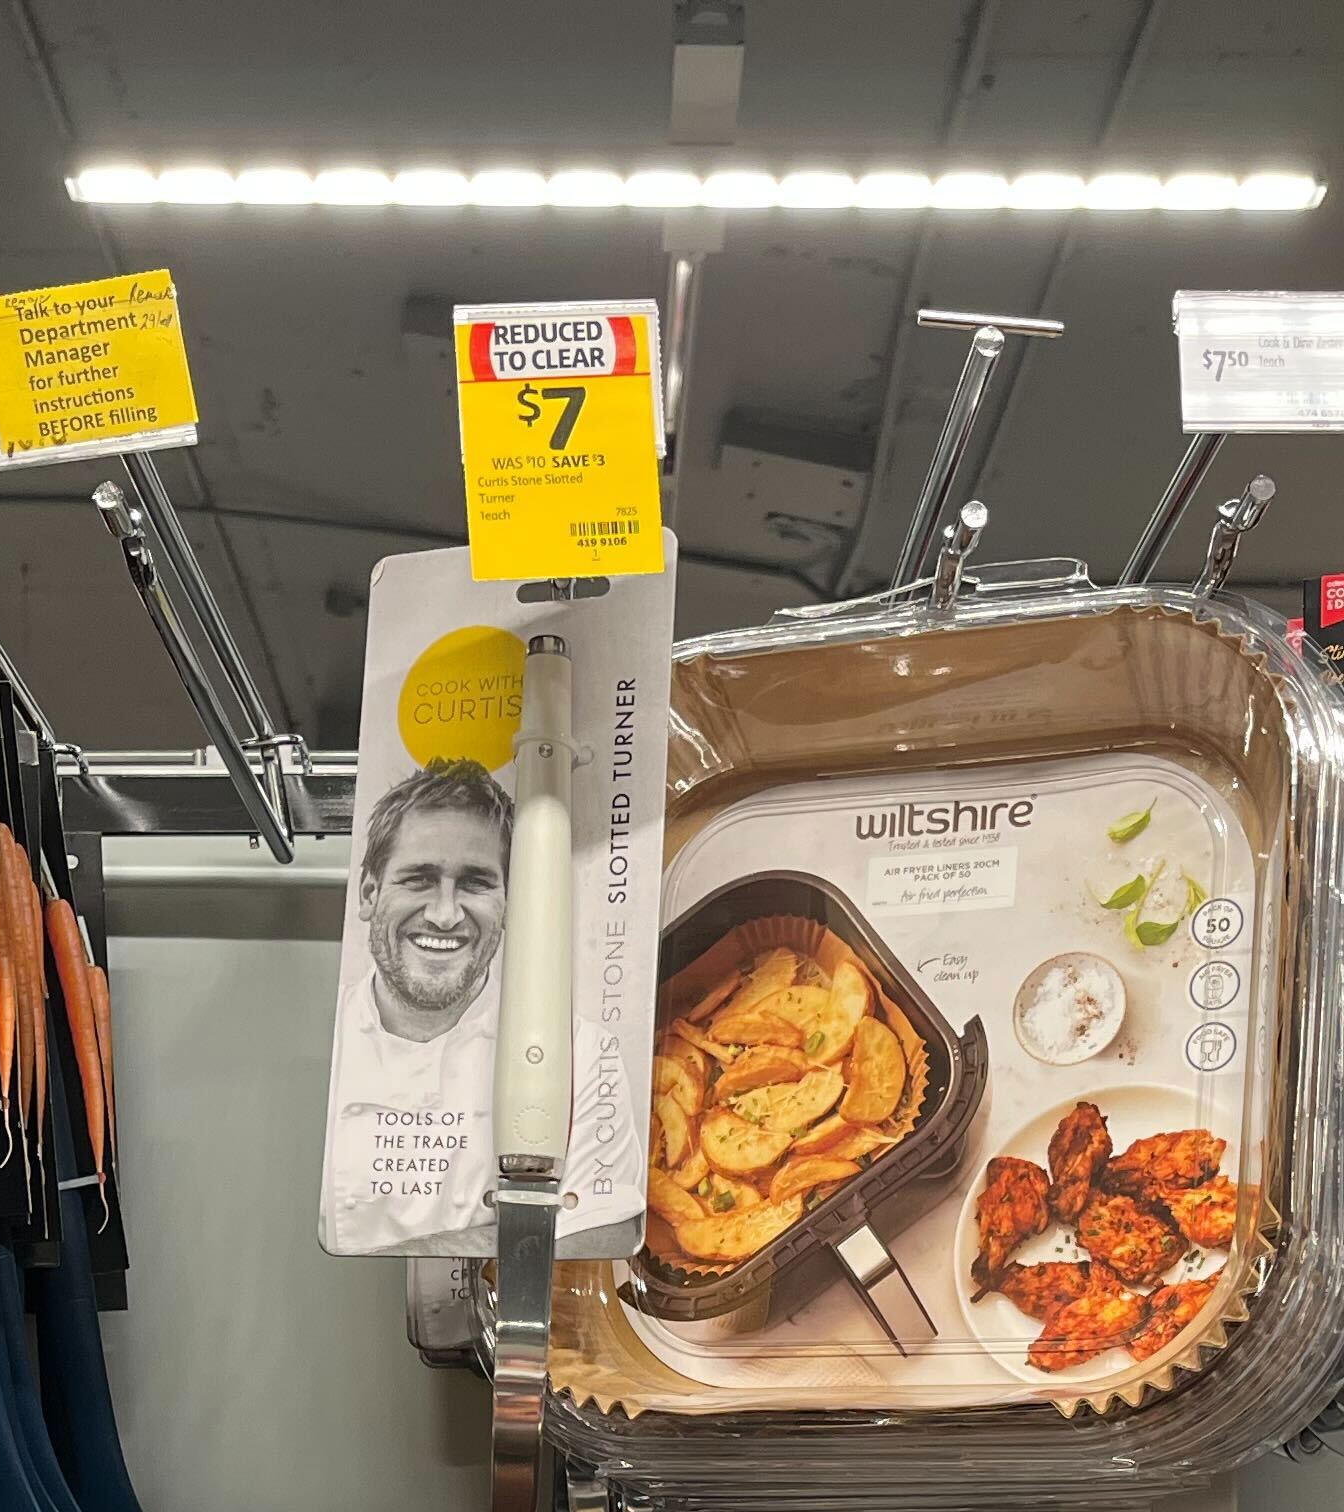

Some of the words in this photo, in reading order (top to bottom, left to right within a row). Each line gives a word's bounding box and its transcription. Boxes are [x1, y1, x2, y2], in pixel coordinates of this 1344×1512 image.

[17, 305, 49, 321] Talk
[55, 303, 71, 316] to
[75, 295, 115, 316] your
[20, 312, 137, 345] Department
[494, 320, 603, 346] REDUCED
[25, 341, 110, 368] Manager
[494, 351, 526, 371] TO
[532, 348, 605, 369] CLEAR
[29, 374, 53, 391] for
[58, 364, 119, 386] further
[35, 389, 135, 414] instructions
[39, 413, 104, 437] BEFORE
[109, 406, 158, 425] filling
[517, 383, 586, 451] $7
[492, 455, 523, 470] WAS
[552, 455, 590, 468] SAVE
[417, 679, 470, 698] COOK
[478, 675, 523, 691] WITH
[413, 694, 523, 725] CURTIS
[613, 677, 636, 782] TURNER
[856, 800, 1034, 840] wiltshire
[608, 793, 631, 904] SLOTTED
[602, 919, 626, 1022] STONE
[596, 1035, 620, 1145] CURTIS
[376, 1112, 433, 1126] TOOLS
[441, 1112, 465, 1125] OF
[374, 1135, 405, 1149] THE
[413, 1136, 468, 1150] TRADE
[373, 1158, 450, 1172] CREATED
[593, 1158, 615, 1195] BY
[370, 1181, 393, 1195] TO
[402, 1181, 444, 1195] LAST
